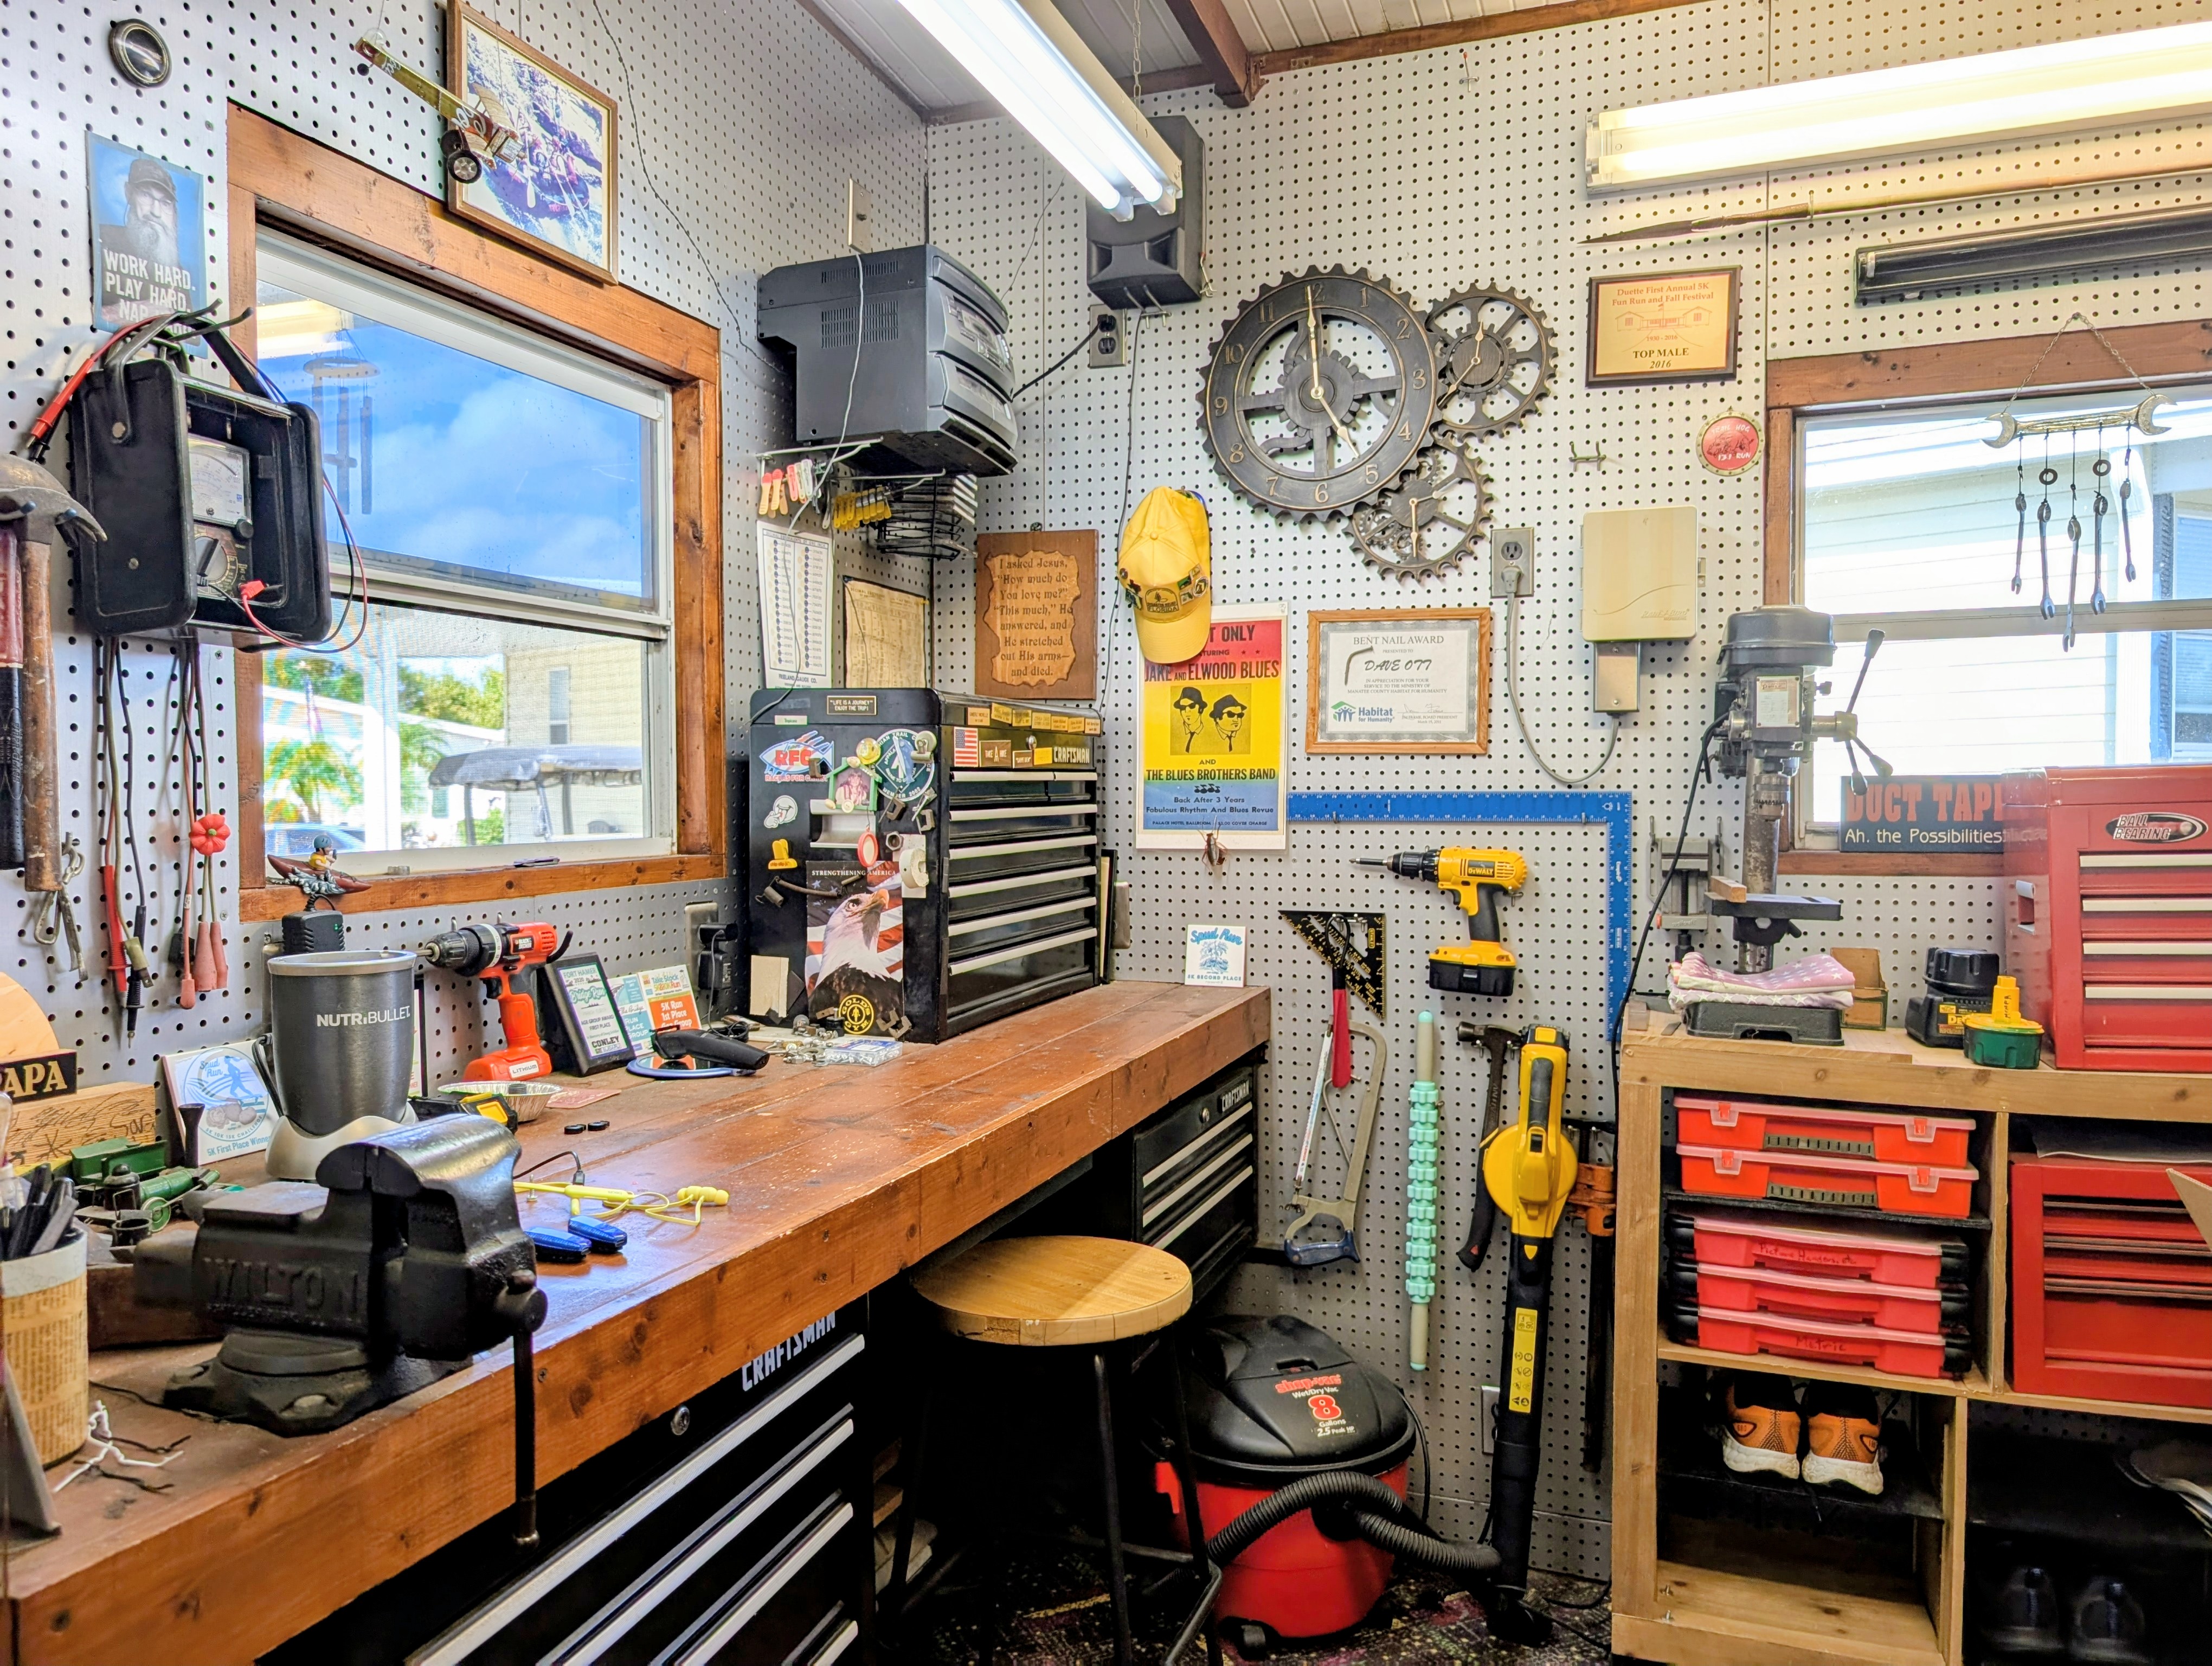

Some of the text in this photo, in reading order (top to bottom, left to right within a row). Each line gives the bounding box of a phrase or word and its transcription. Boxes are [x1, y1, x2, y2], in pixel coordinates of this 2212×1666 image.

[104, 248, 196, 291] WORK HARD.
[106, 272, 191, 312] PLAY HARD.
[1617, 287, 1644, 296] Duette
[1666, 283, 1696, 292] Annual
[1697, 282, 1709, 290] 5K
[1359, 287, 1369, 308] 1
[1612, 292, 1714, 306] Fun Run and Fall Festival
[119, 299, 149, 323] NAP
[1258, 302, 1275, 323] 11
[1397, 318, 1410, 340] 2
[1223, 343, 1245, 364] 10
[1632, 348, 1689, 359] TOP MALE
[1649, 360, 1671, 369] 2016
[1413, 369, 1426, 389] 3
[1214, 396, 1228, 416] 9
[1397, 425, 1412, 441] 4
[1735, 424, 1751, 433] HOG
[1230, 443, 1245, 464] 8
[1365, 464, 1379, 485] 5
[1266, 476, 1279, 497] 7
[1314, 483, 1329, 503] 6
[1006, 558, 1068, 569] asked Jesus,
[1027, 573, 1067, 585] much do
[1000, 589, 1040, 602] You love
[1059, 604, 1073, 614] He
[1000, 619, 1067, 631] answered, and
[1004, 636, 1063, 646] He stretched
[1221, 625, 1256, 642] ONLY
[1353, 636, 1444, 645] BENT NAIL AWARD
[1001, 651, 1034, 661] out His
[1011, 666, 1053, 677] and died.
[1144, 660, 1279, 682] JAKE AND ELWOOD BLUES
[1364, 659, 1432, 671] DAVE OTT
[1358, 707, 1393, 716] Habitat
[775, 749, 812, 766] RFC
[1053, 746, 1090, 764] CRAFTSMAN
[1146, 768, 1276, 781] THE BLUES BROTHERS BAND
[1846, 783, 1922, 822] DUCT
[2117, 815, 2150, 827] BALL
[1876, 829, 1901, 843] the
[1910, 828, 2003, 843] Possibilities
[2113, 827, 2171, 840] BEARING
[1190, 927, 1243, 945] Spud Run
[569, 986, 606, 1003] Bridge Run
[661, 1001, 683, 1011] 5K Run
[842, 998, 871, 1016] GOLD'S
[661, 1010, 687, 1021] 1st Place
[591, 1036, 620, 1048] CONLEY
[200, 1058, 220, 1072] Spud
[512, 1063, 537, 1074] LITHIUM
[0, 1060, 67, 1098] APA
[207, 1068, 223, 1078] Run
[1222, 1080, 1249, 1112] CRAFTSMAN
[237, 1115, 263, 1138] CHALLENGE
[207, 1146, 216, 1156] 5K
[217, 1143, 232, 1153] First
[233, 1140, 249, 1150] Place
[203, 1257, 359, 1313] WILTON
[742, 1310, 835, 1392] CRAFTSMAN
[1796, 1336, 1846, 1351] Metric
[1292, 1388, 1324, 1399] Wet/Dry
[1308, 1394, 1342, 1420] 8
[1319, 1419, 1346, 1427] Gallons
[1317, 1427, 1330, 1437] 2.5
